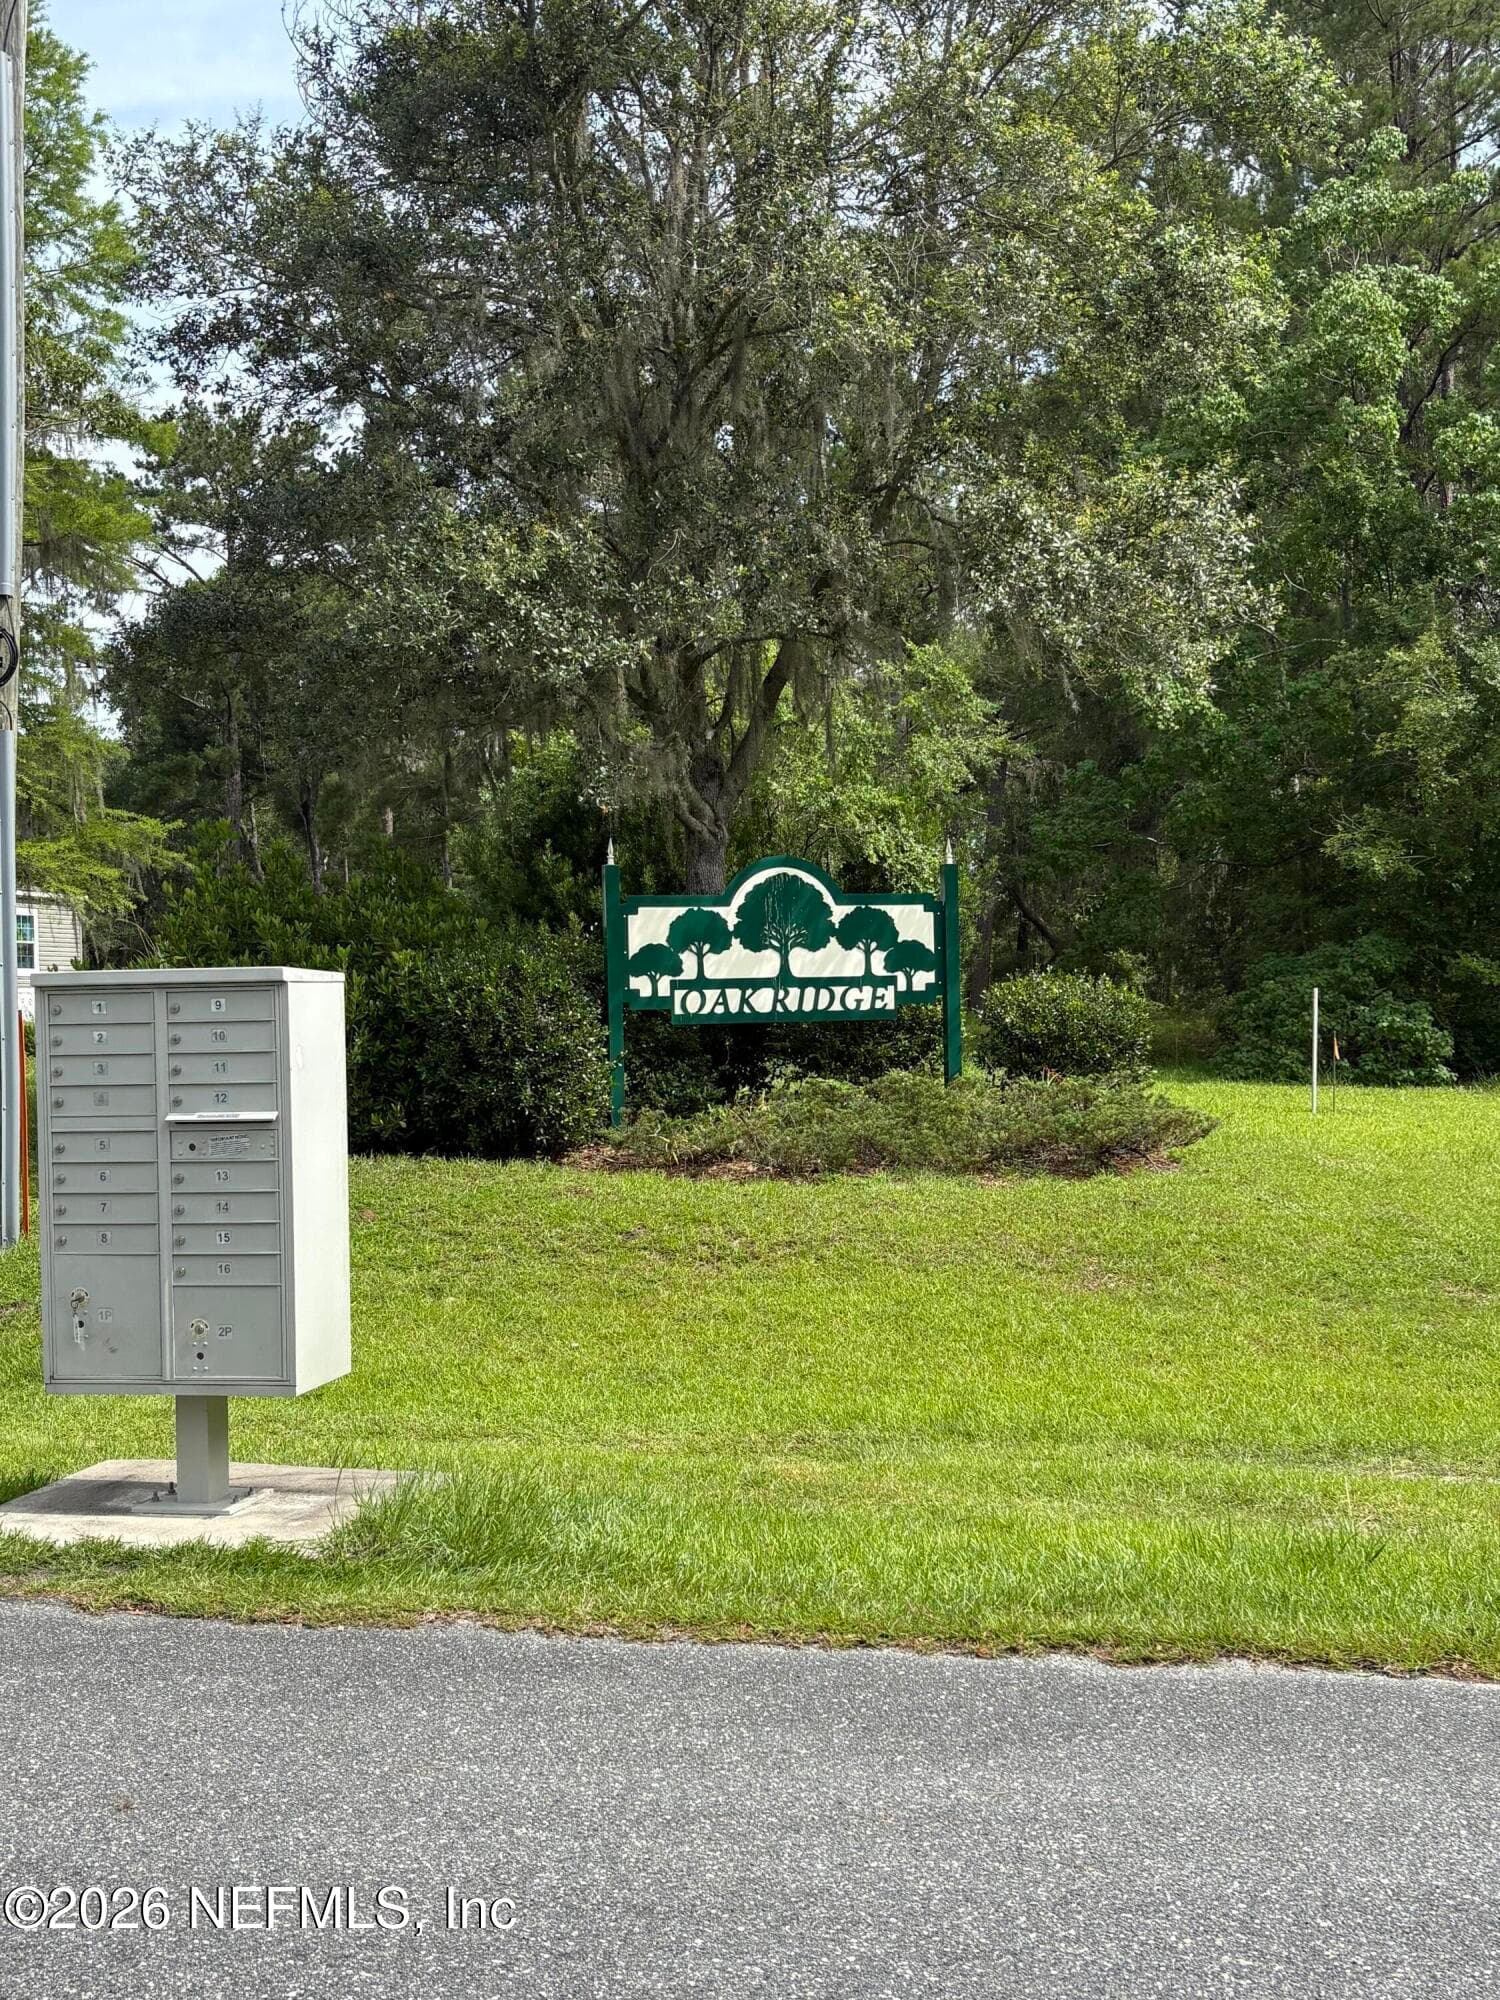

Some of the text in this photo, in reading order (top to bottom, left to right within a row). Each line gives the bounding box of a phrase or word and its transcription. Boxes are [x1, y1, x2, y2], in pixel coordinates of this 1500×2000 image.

[97, 1003, 102, 1012] 1
[215, 1001, 222, 1010] 9
[96, 1033, 104, 1043] 2
[213, 1031, 226, 1041] 10
[97, 1064, 104, 1074] 3
[214, 1063, 226, 1072] 11
[214, 1093, 227, 1103] 12
[99, 1141, 106, 1150] 5
[100, 1172, 106, 1182] 6
[216, 1171, 229, 1181] 13
[100, 1203, 107, 1212] 7
[216, 1202, 229, 1212] 14
[101, 1233, 108, 1243] 8
[217, 1233, 230, 1243] 15
[217, 1264, 231, 1274] 16
[98, 1311, 112, 1321] 1P
[218, 1327, 232, 1337] 2P
